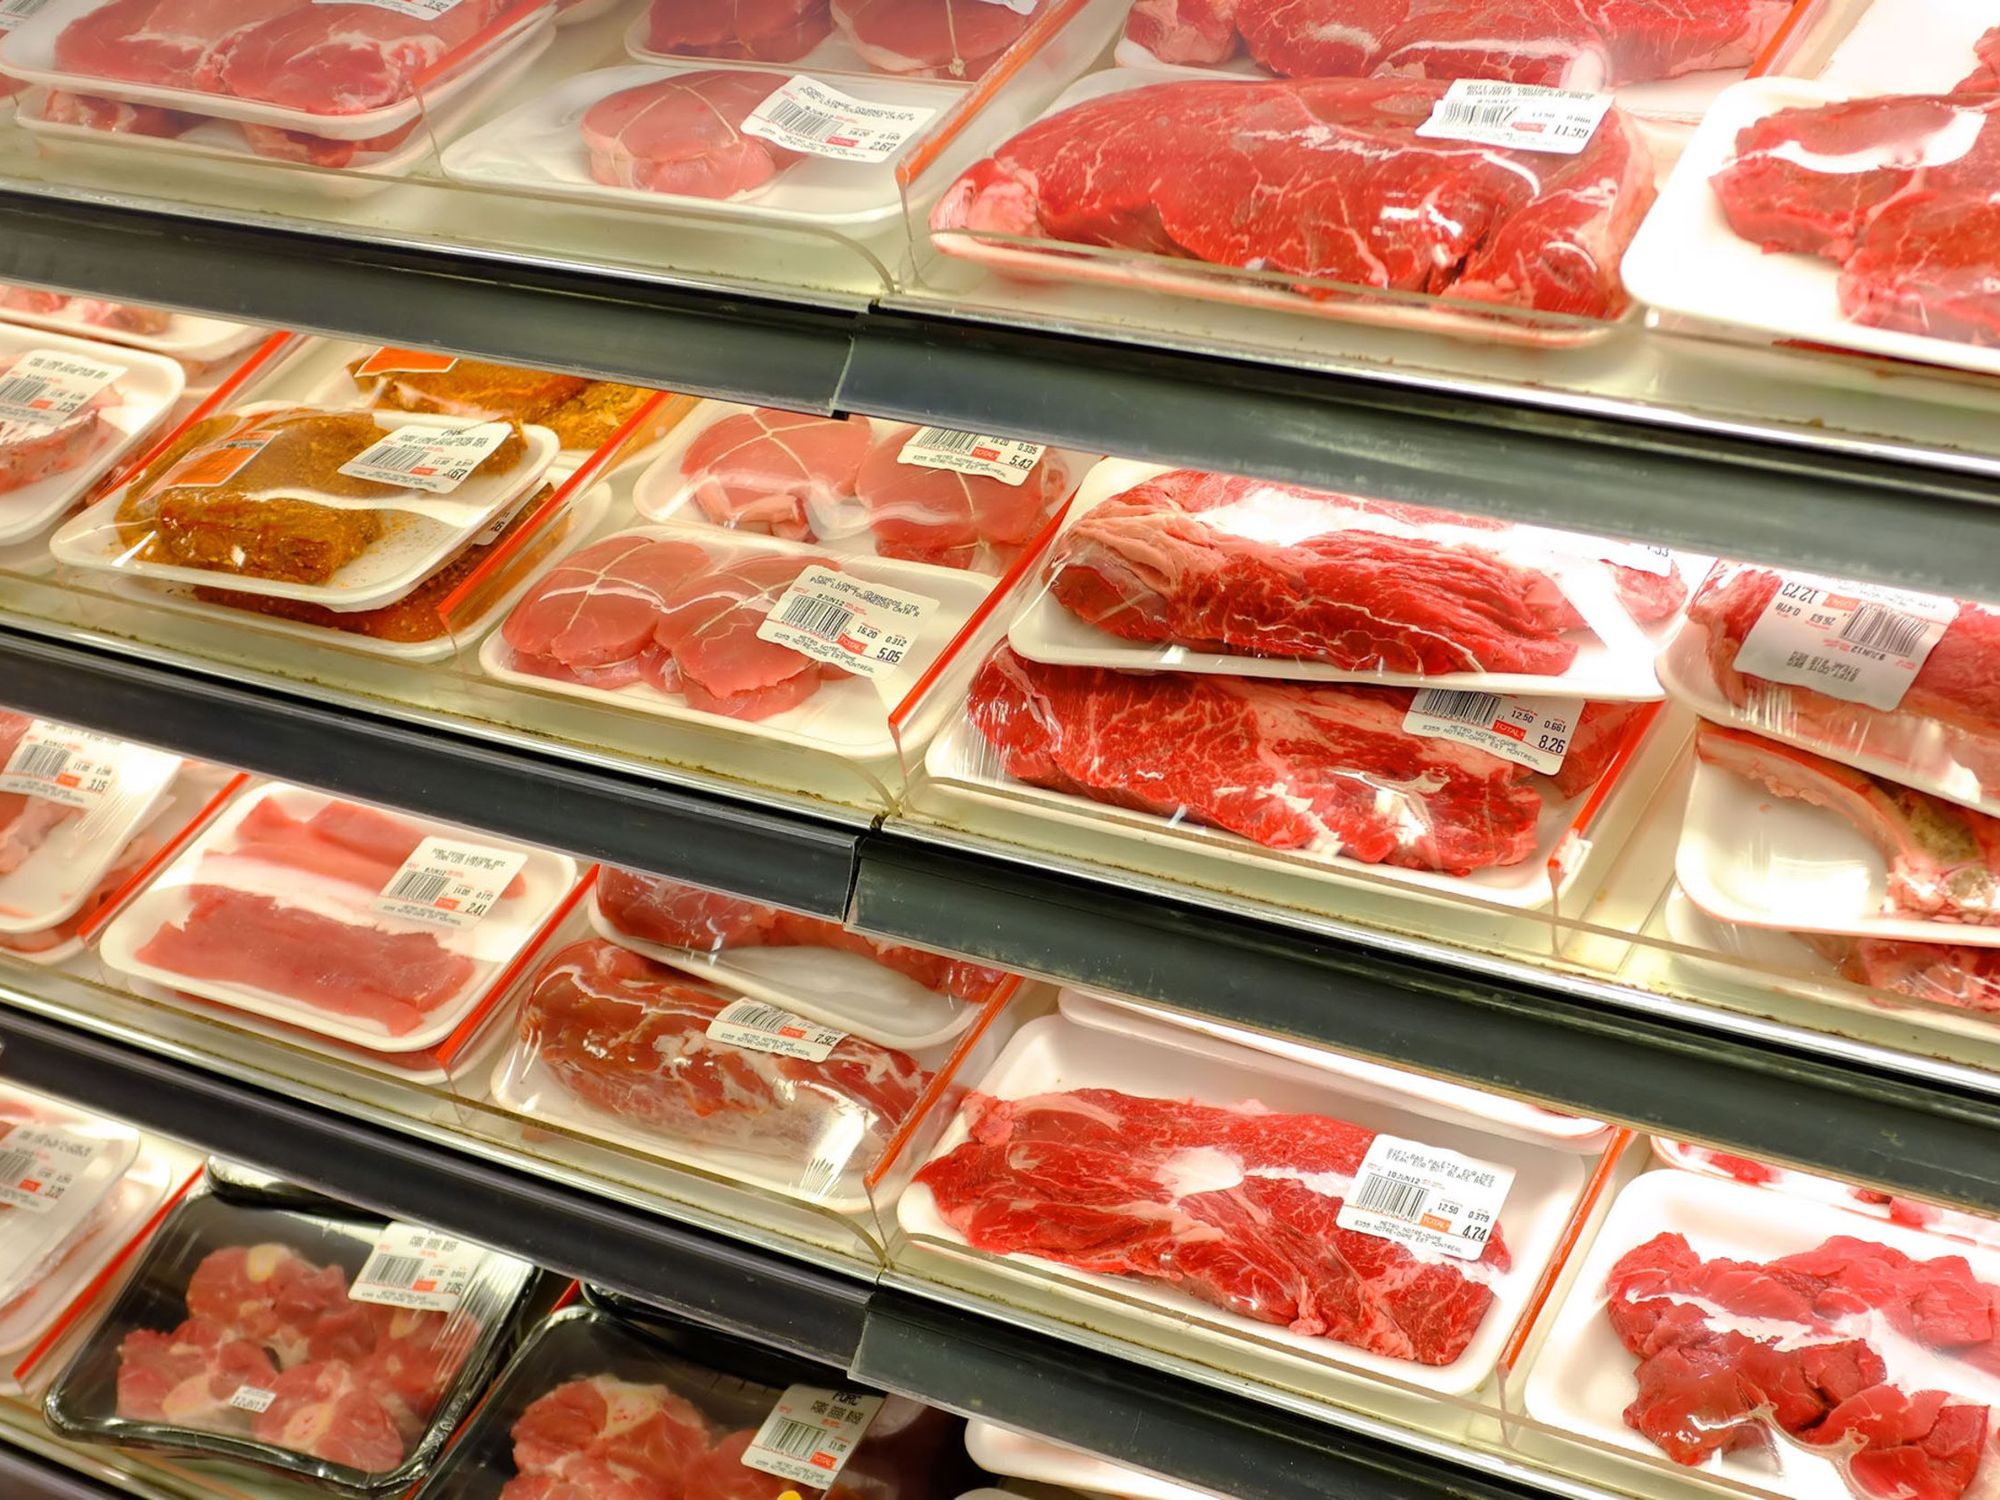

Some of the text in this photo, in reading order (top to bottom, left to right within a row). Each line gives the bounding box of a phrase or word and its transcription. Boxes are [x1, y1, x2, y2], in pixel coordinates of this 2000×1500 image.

[1017, 443, 1038, 455] 0.335
[1009, 455, 1034, 469] 5.43
[1782, 582, 1819, 604] 12.73
[1775, 602, 1836, 625] 26.63 0.478
[857, 626, 908, 647] 16.20 0.312
[877, 648, 903, 663] 5.05
[1511, 709, 1567, 733] 12.50 0.661
[1538, 735, 1566, 754] 8.26
[465, 902, 487, 916] 2.41
[815, 1033, 838, 1047] 7.92
[1437, 1203, 1490, 1223] 12.50 0.379
[1462, 1224, 1488, 1241] 4.74
